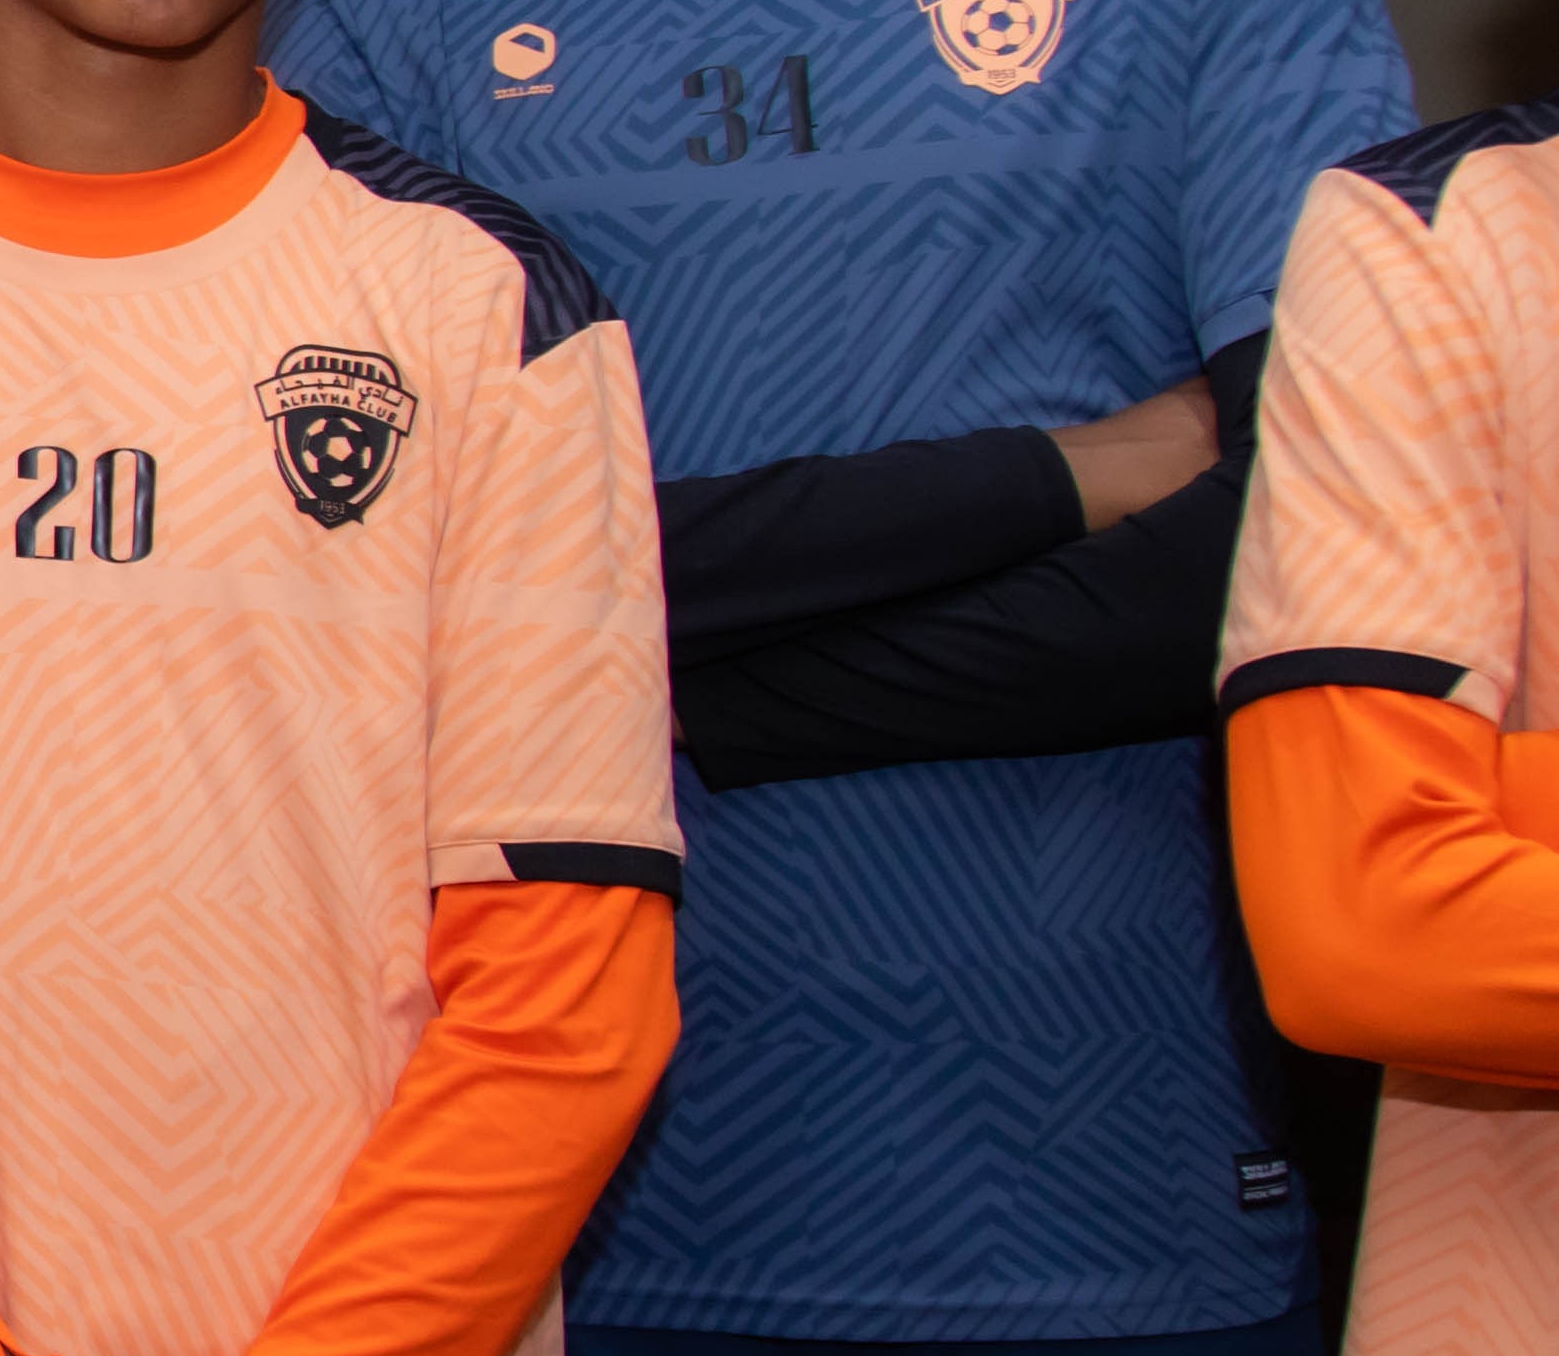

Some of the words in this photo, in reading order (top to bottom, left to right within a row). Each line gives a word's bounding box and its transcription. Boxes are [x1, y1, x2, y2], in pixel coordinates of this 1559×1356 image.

[681, 53, 820, 167] 34
[280, 393, 352, 410] ALFAYHA
[357, 399, 398, 424] CLUB
[14, 445, 158, 563] 20
